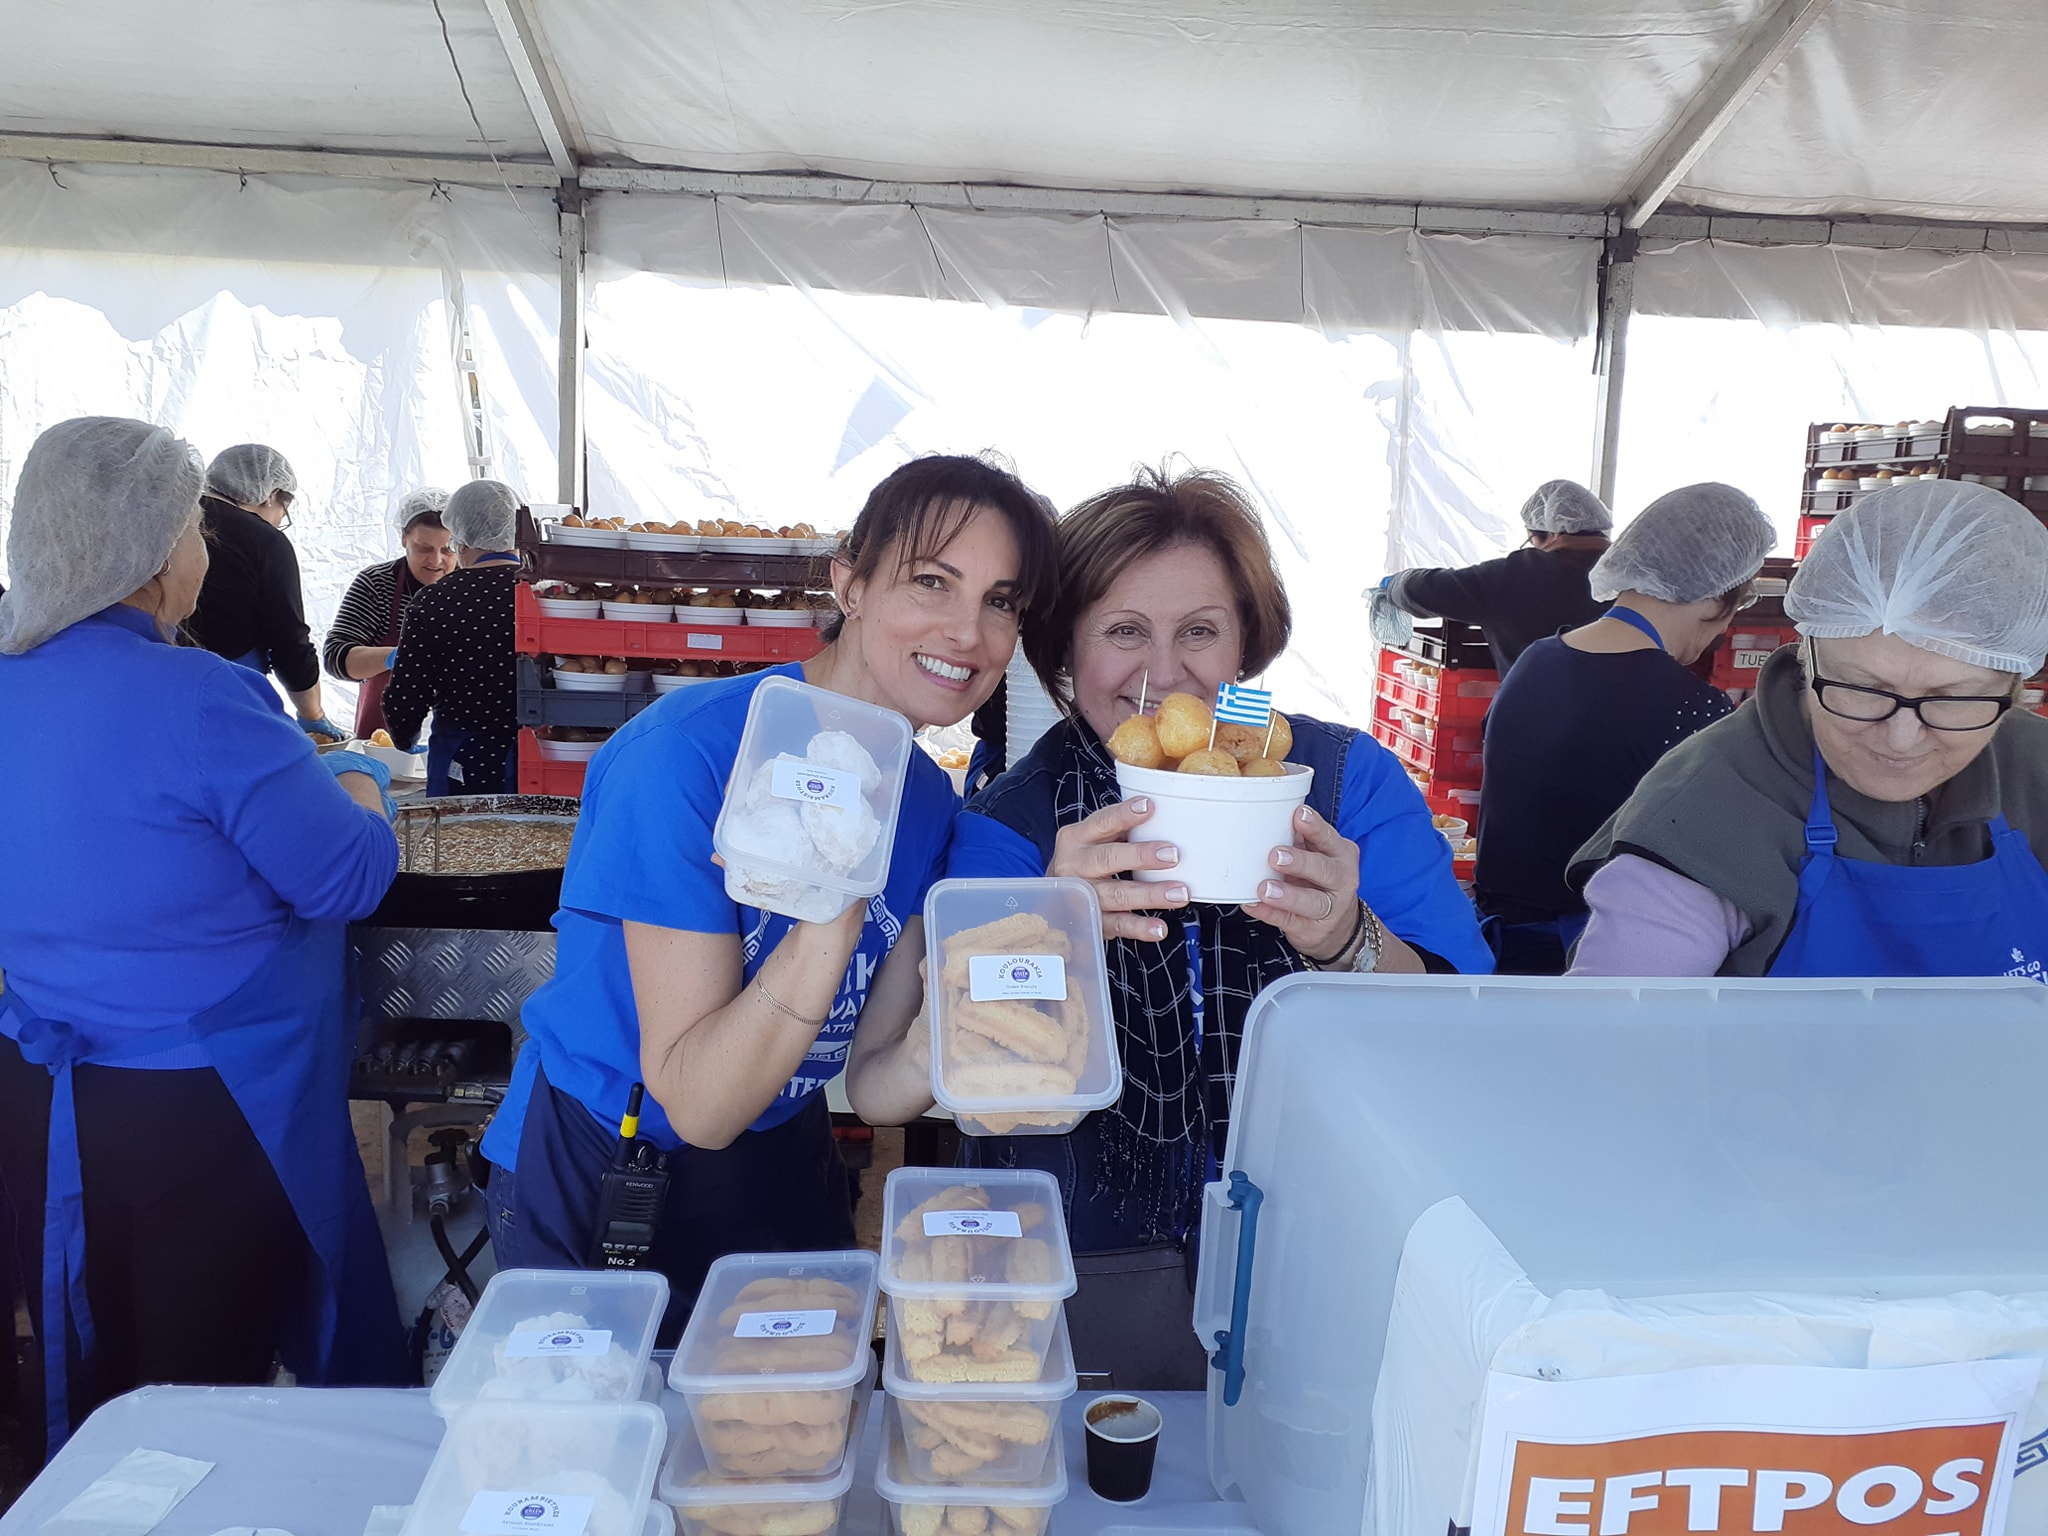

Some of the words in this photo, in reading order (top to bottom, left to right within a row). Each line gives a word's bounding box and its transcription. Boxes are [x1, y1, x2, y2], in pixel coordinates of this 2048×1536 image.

[998, 957, 1043, 979] KOULOURAKIA
[2027, 960, 2041, 973] GO
[625, 1181, 654, 1189] KENWOOD
[607, 1256, 636, 1267] No.2
[1523, 1458, 1985, 1536] EFTPOS
